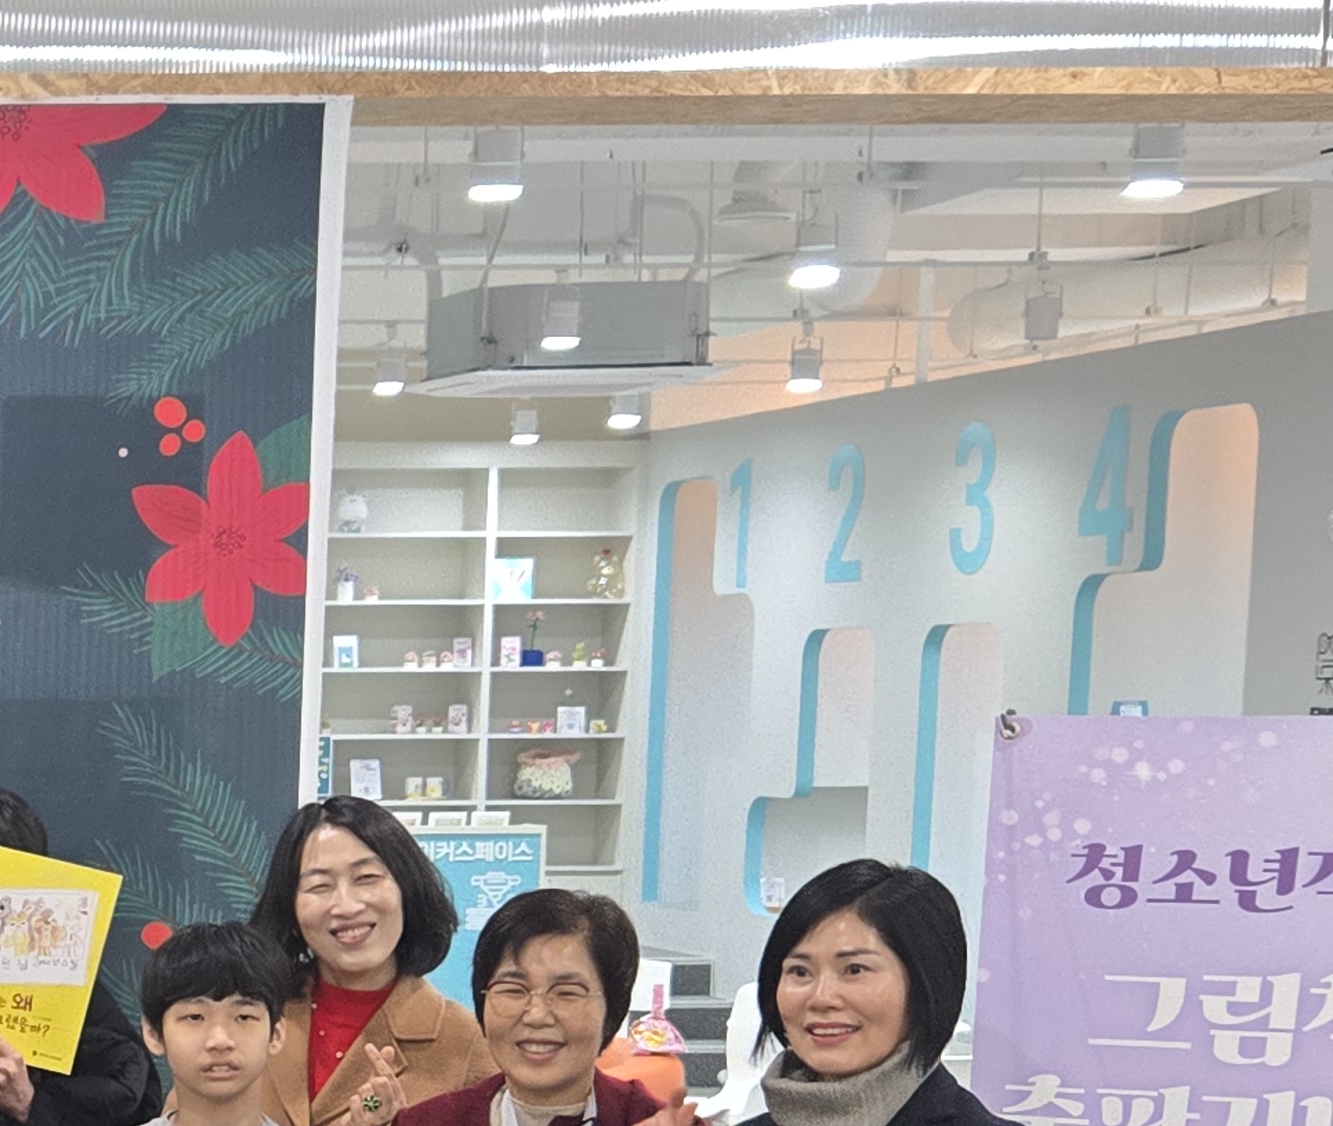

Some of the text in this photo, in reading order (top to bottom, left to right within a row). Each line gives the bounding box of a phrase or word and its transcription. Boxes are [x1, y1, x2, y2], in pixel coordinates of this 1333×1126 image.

[730, 405, 1133, 588] 1 2 3 4
[11, 993, 34, 1012] 왜
